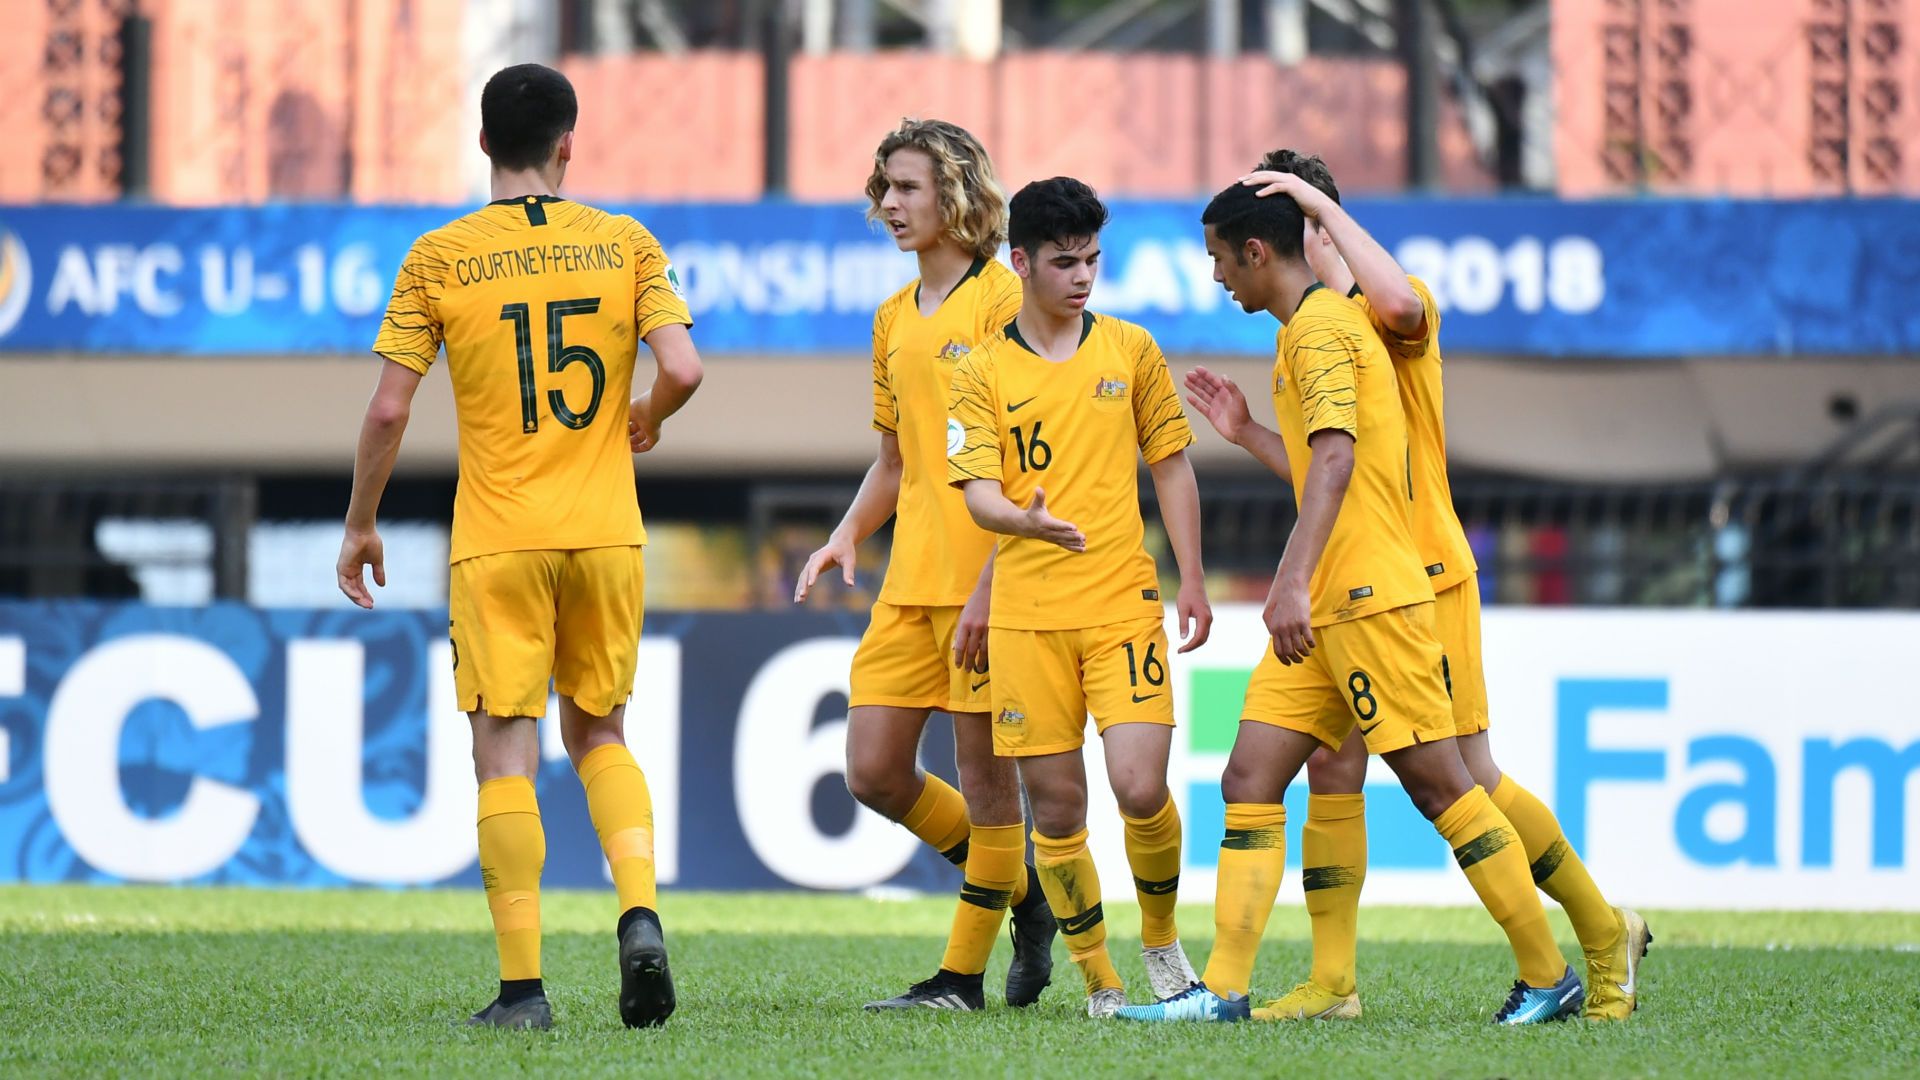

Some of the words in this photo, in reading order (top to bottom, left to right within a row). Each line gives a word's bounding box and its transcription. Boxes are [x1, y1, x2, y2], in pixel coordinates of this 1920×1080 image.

[46, 243, 185, 318] AFC
[198, 243, 385, 318] U-16
[1397, 235, 1605, 315] 2018
[456, 242, 624, 286] COURTNEY-PERKINS
[499, 297, 606, 434] 15
[1009, 420, 1053, 473] 16
[1121, 641, 1164, 687] 16
[1348, 671, 1378, 721] 8
[1553, 677, 1920, 870] Fam
